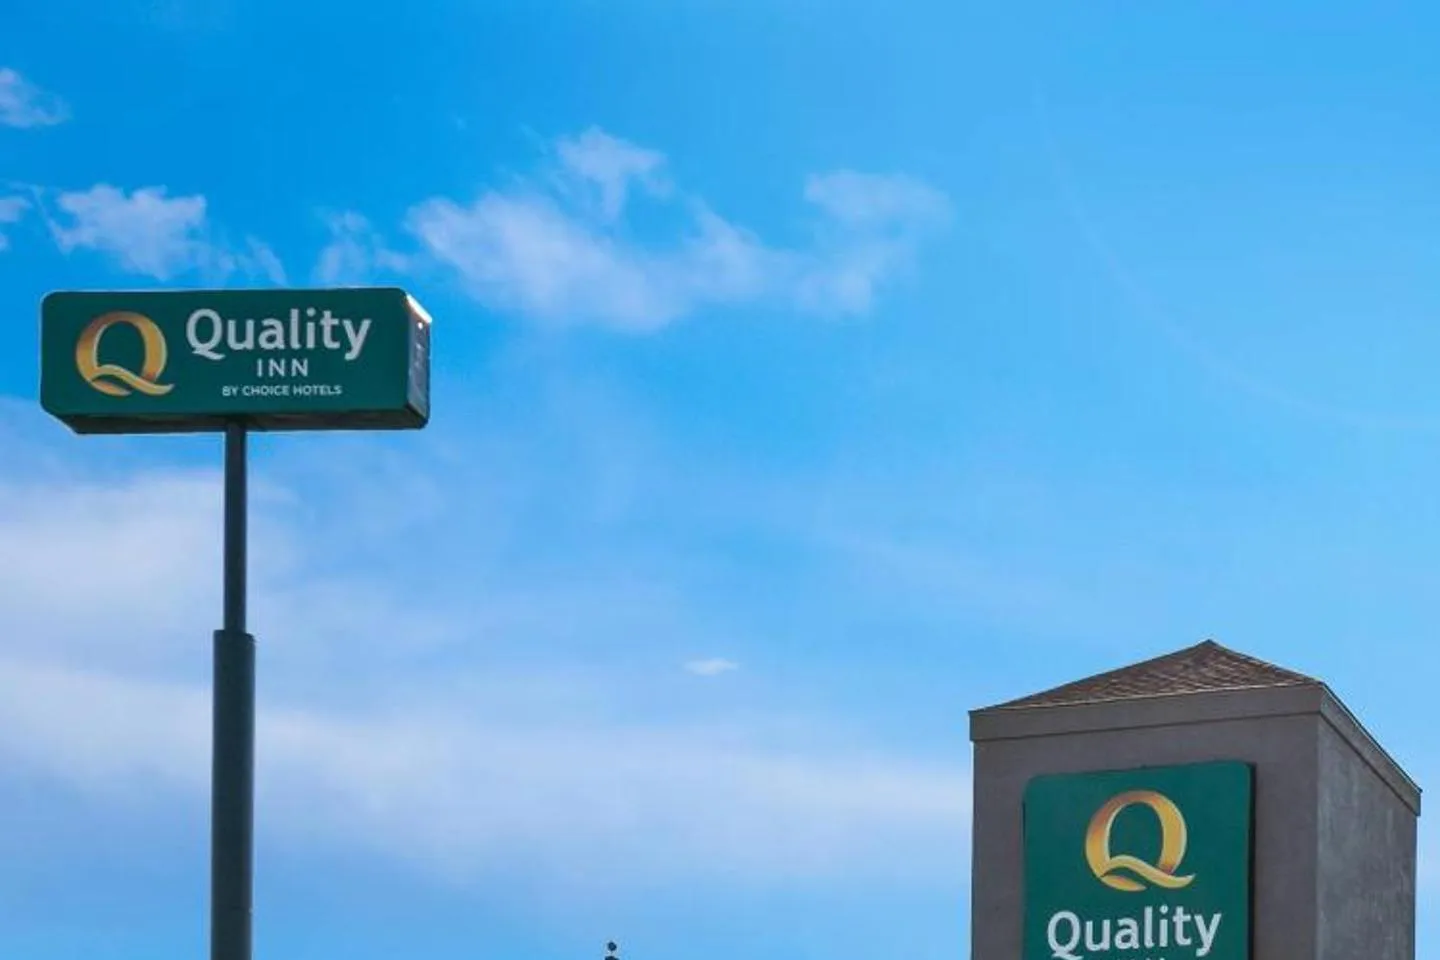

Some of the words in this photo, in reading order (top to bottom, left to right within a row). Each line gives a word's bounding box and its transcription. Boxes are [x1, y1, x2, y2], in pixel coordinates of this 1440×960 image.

[75, 311, 174, 396] Q
[186, 307, 372, 361] Quality
[221, 385, 239, 397] BY
[242, 385, 290, 397] CHOICE
[293, 384, 342, 396] HOTELS
[256, 358, 309, 377] INN
[1085, 789, 1196, 892] Q
